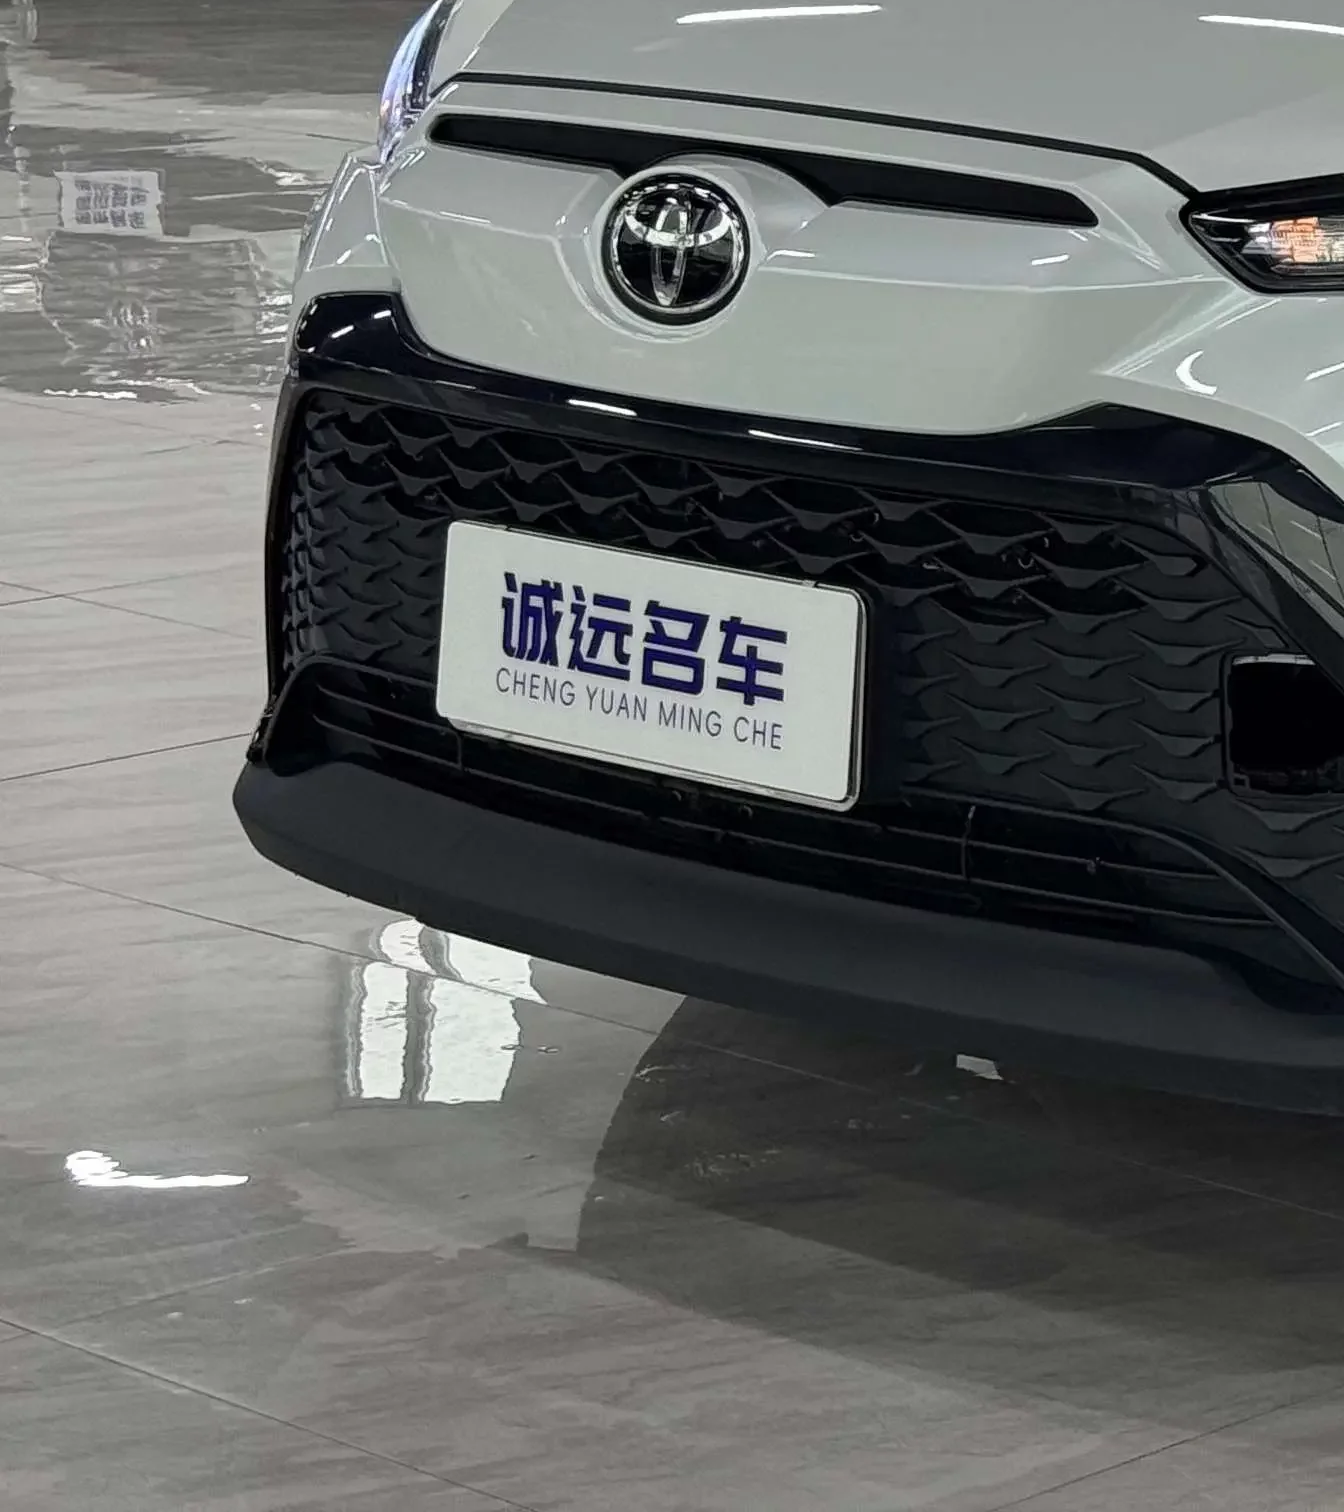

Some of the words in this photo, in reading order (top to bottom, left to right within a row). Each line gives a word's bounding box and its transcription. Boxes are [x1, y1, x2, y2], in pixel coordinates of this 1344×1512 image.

[502, 572, 788, 705] 诚远名车
[496, 667, 576, 706] CHENG
[585, 685, 648, 722] YUAN
[659, 701, 722, 737] MING
[733, 716, 783, 750] CHE
